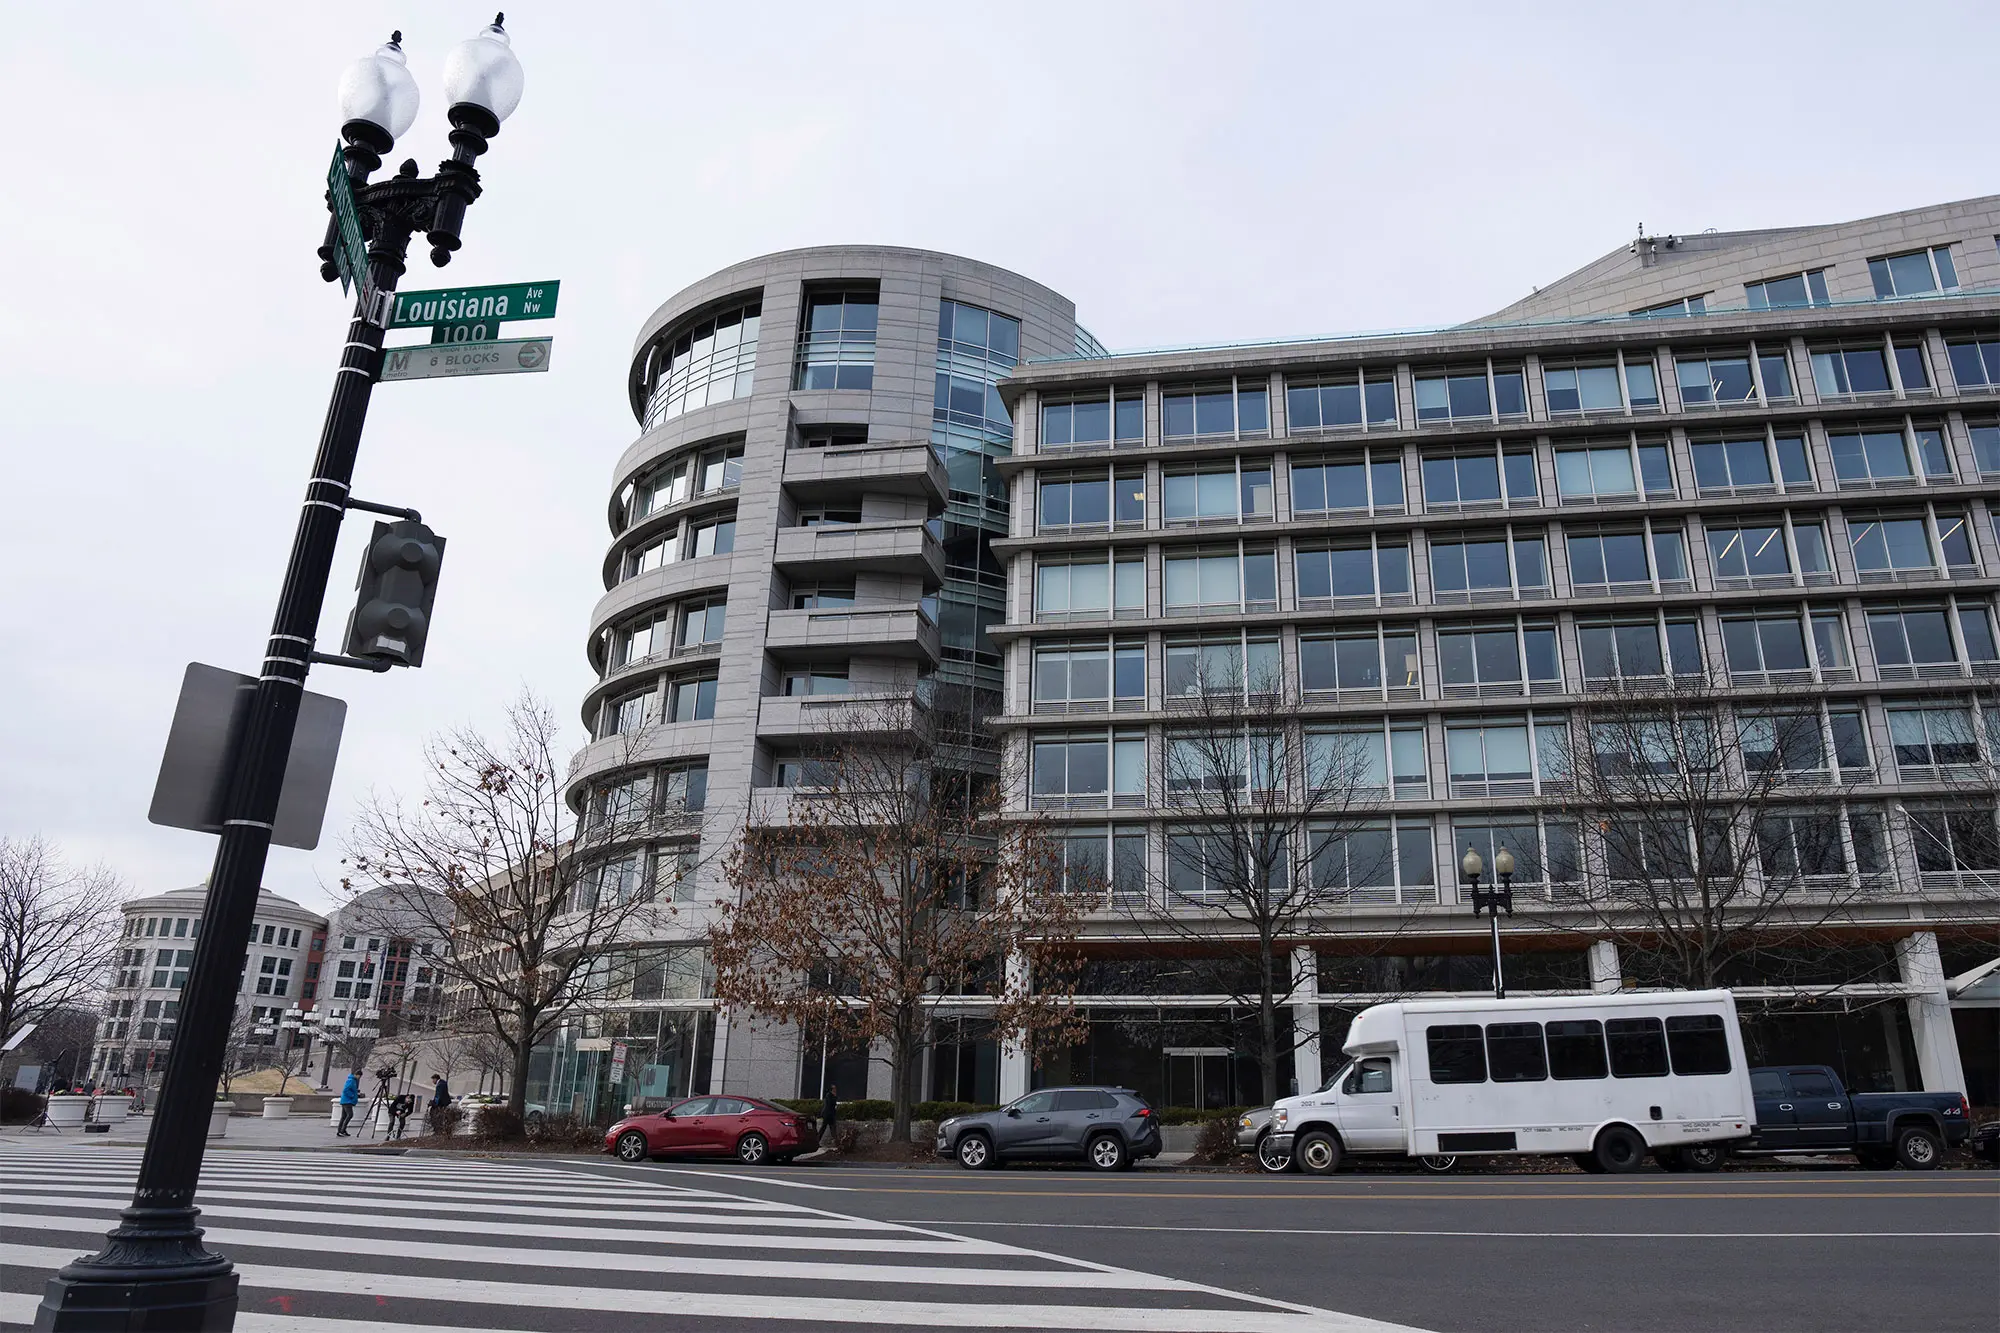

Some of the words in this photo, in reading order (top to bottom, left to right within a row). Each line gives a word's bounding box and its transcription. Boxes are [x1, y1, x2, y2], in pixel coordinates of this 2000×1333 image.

[526, 287, 543, 299] Ave
[394, 291, 509, 323] Louisiana
[443, 324, 487, 344] 100
[430, 356, 438, 366] 6
[445, 352, 500, 365] BLOCKS
